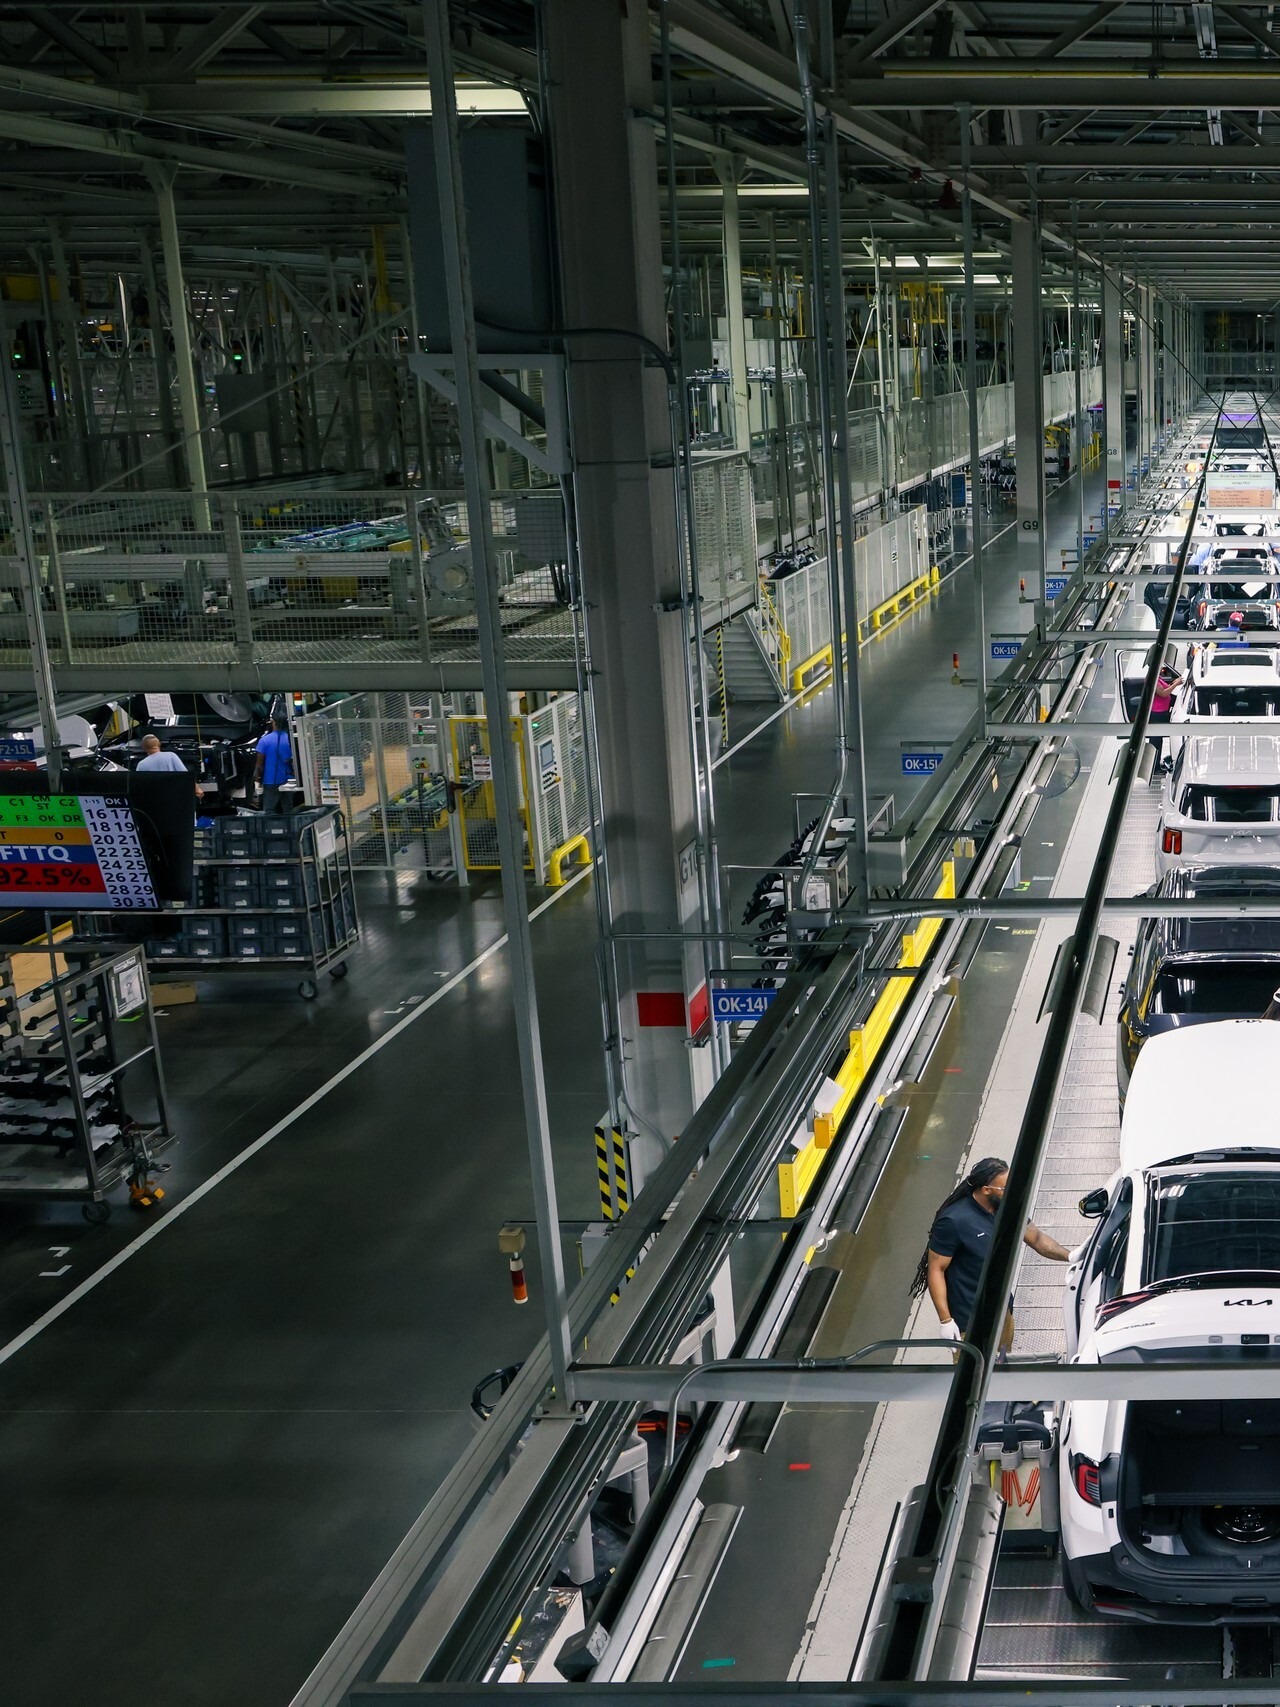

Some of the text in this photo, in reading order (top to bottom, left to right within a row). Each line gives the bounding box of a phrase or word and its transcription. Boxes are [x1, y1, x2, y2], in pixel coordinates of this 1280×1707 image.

[1107, 448, 1118, 456] G8
[1022, 520, 1039, 531] G9
[59, 798, 76, 807] C2
[105, 798, 121, 806] OK
[39, 814, 56, 822] OK
[63, 814, 82, 822] DR
[86, 809, 130, 820] 16 17
[90, 821, 135, 833] 18 19
[92, 834, 138, 845] 20 21
[96, 847, 143, 858] 22 23
[100, 860, 147, 870] 24 25
[104, 872, 149, 883] 26 27
[108, 885, 154, 895] 28 29
[113, 897, 156, 908] 30 31
[1223, 1299, 1273, 1307] KIA
